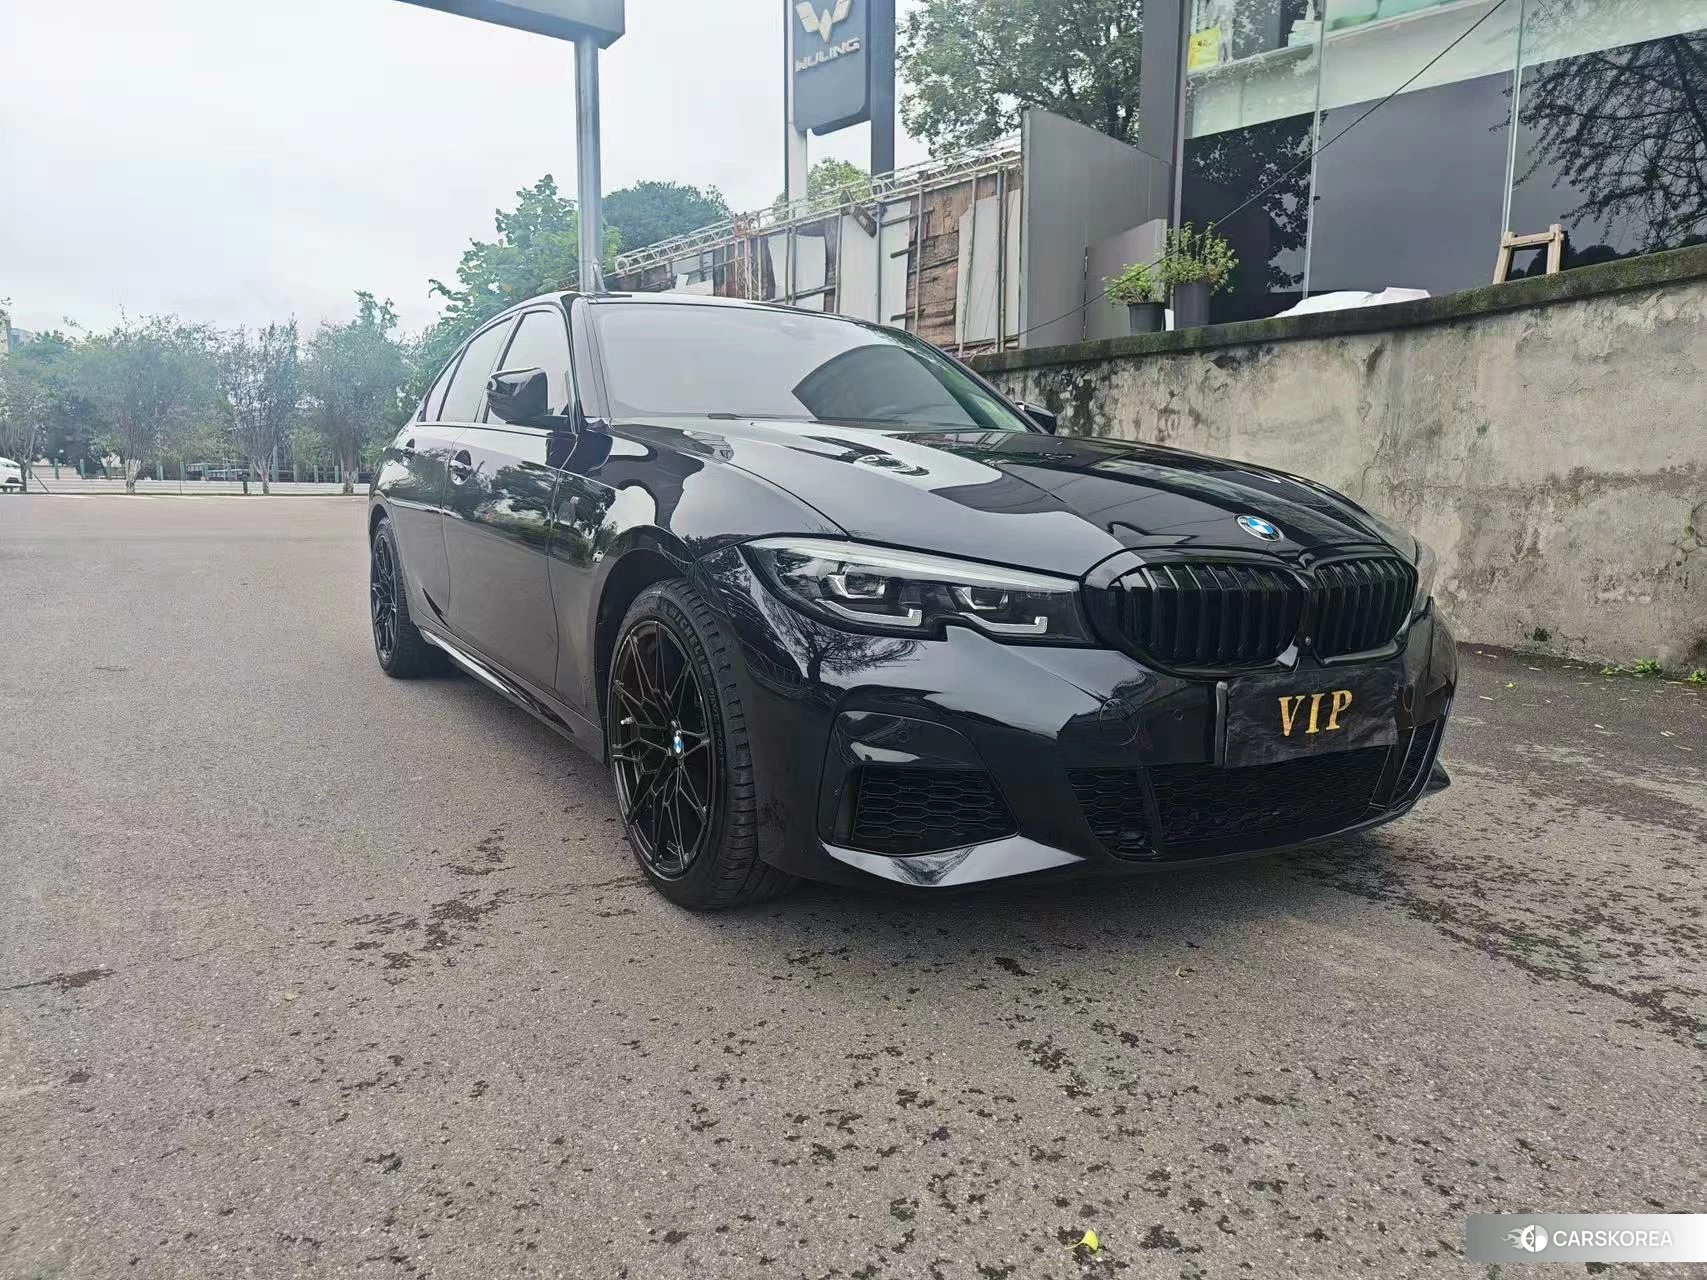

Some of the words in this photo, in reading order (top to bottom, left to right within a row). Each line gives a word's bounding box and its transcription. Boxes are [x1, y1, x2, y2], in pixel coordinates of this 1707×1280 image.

[796, 37, 860, 72] WULING
[667, 605, 711, 676] MICHELIN
[1279, 690, 1353, 736] VIP
